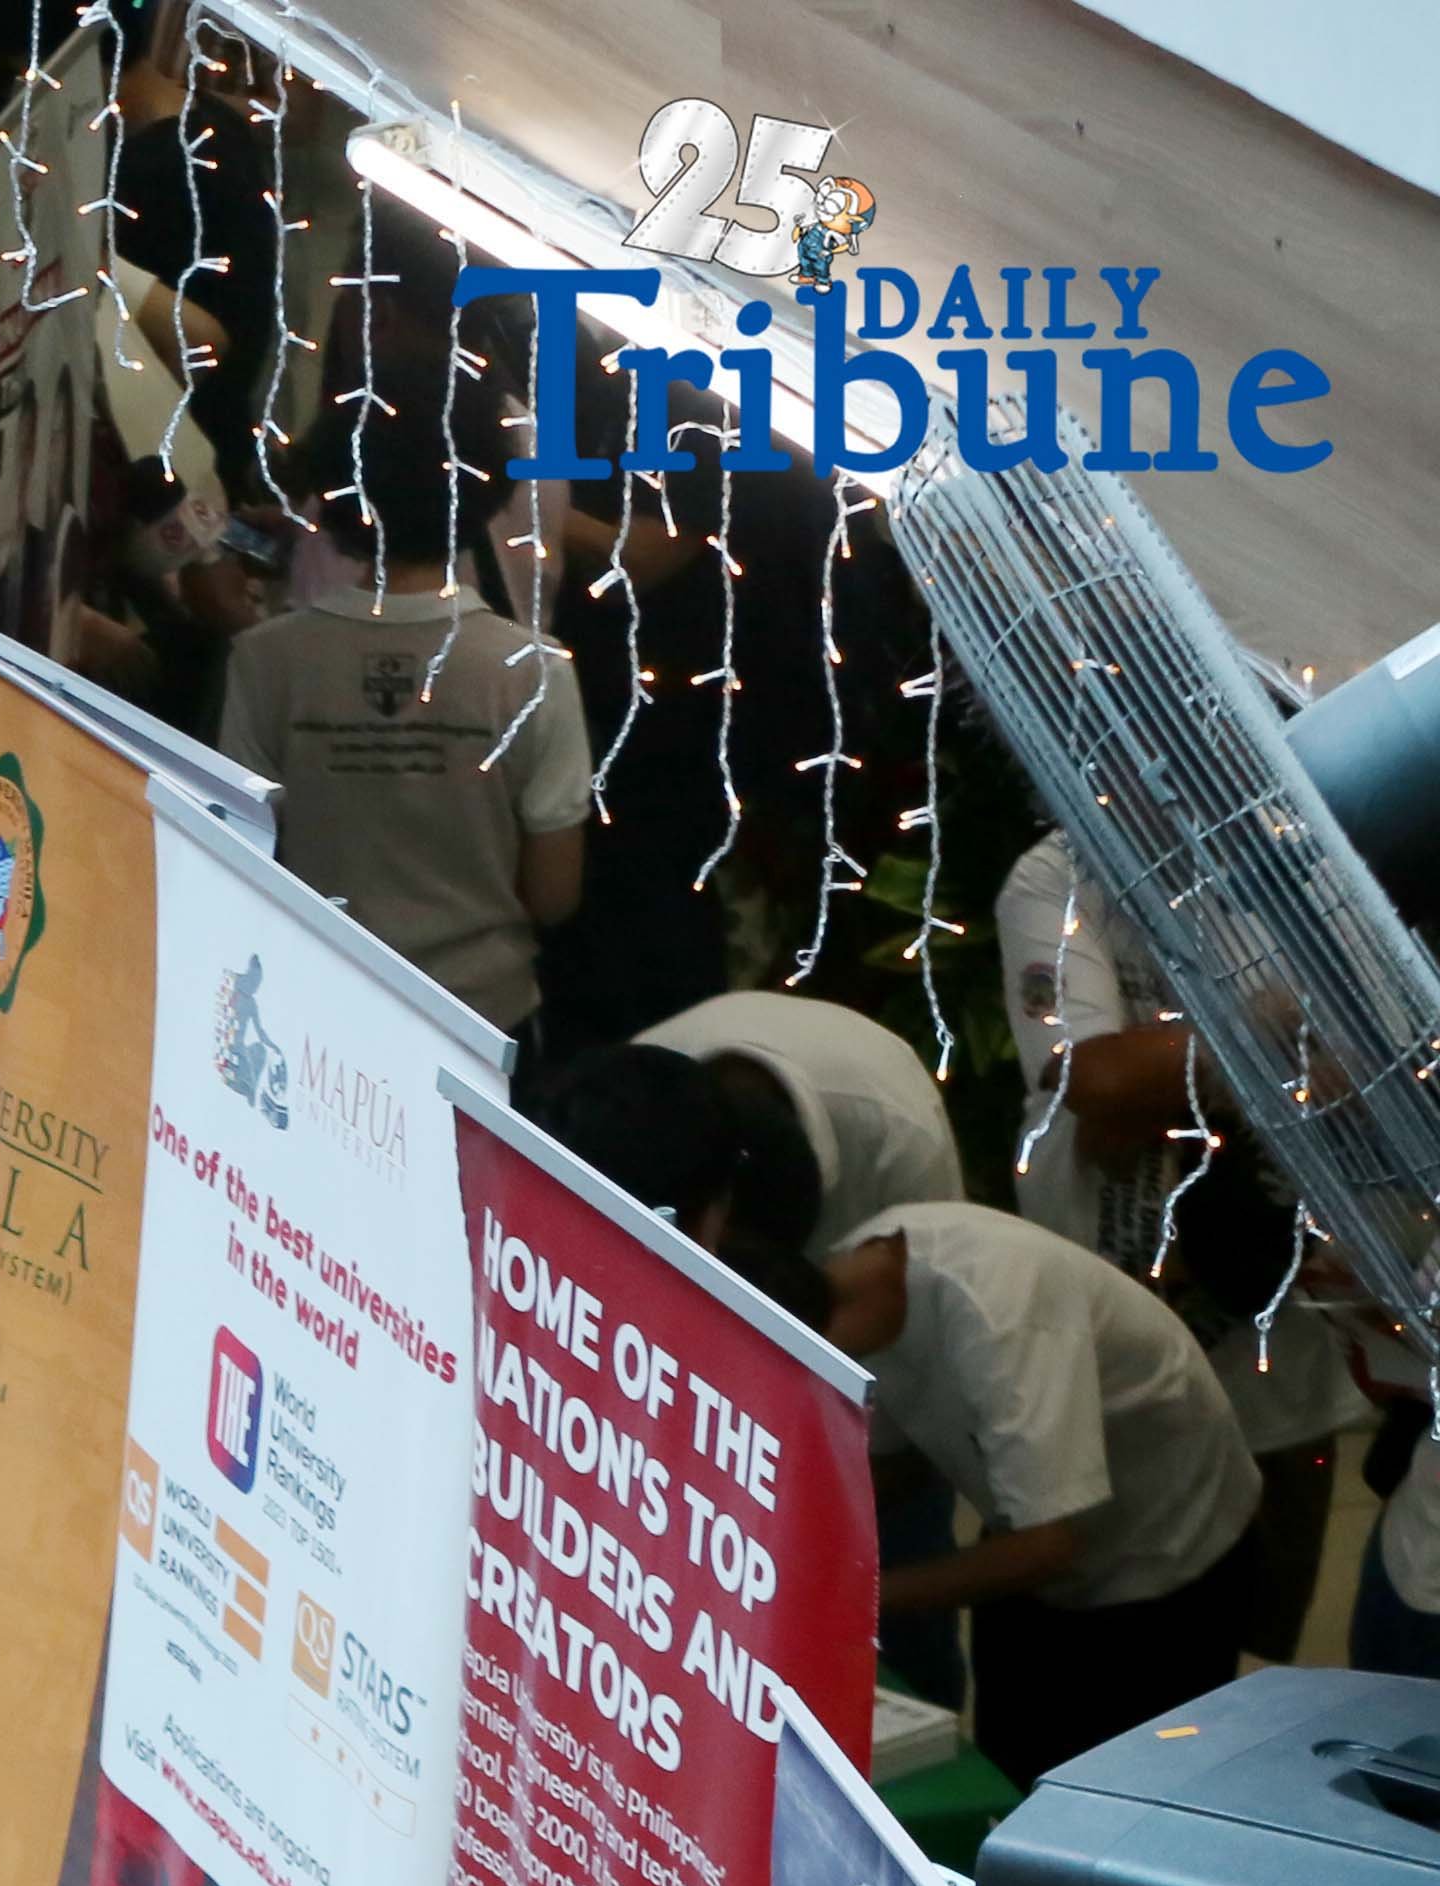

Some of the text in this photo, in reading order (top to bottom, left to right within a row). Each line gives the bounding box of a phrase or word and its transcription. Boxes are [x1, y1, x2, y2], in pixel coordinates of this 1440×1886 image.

[298, 1034, 409, 1175] MAPÚA
[153, 1104, 458, 1385] One of the best universities
[226, 1222, 361, 1371] in the world
[213, 1351, 257, 1468] THE
[272, 1371, 318, 1433] World
[482, 1206, 781, 1513] HOME OF THE
[270, 1409, 347, 1501] University
[476, 1310, 776, 1614] NATION'S TOP
[465, 1526, 682, 1772] CREATORS
[472, 1421, 786, 1745] BUILDERS AND
[464, 1644, 509, 1694] apúa
